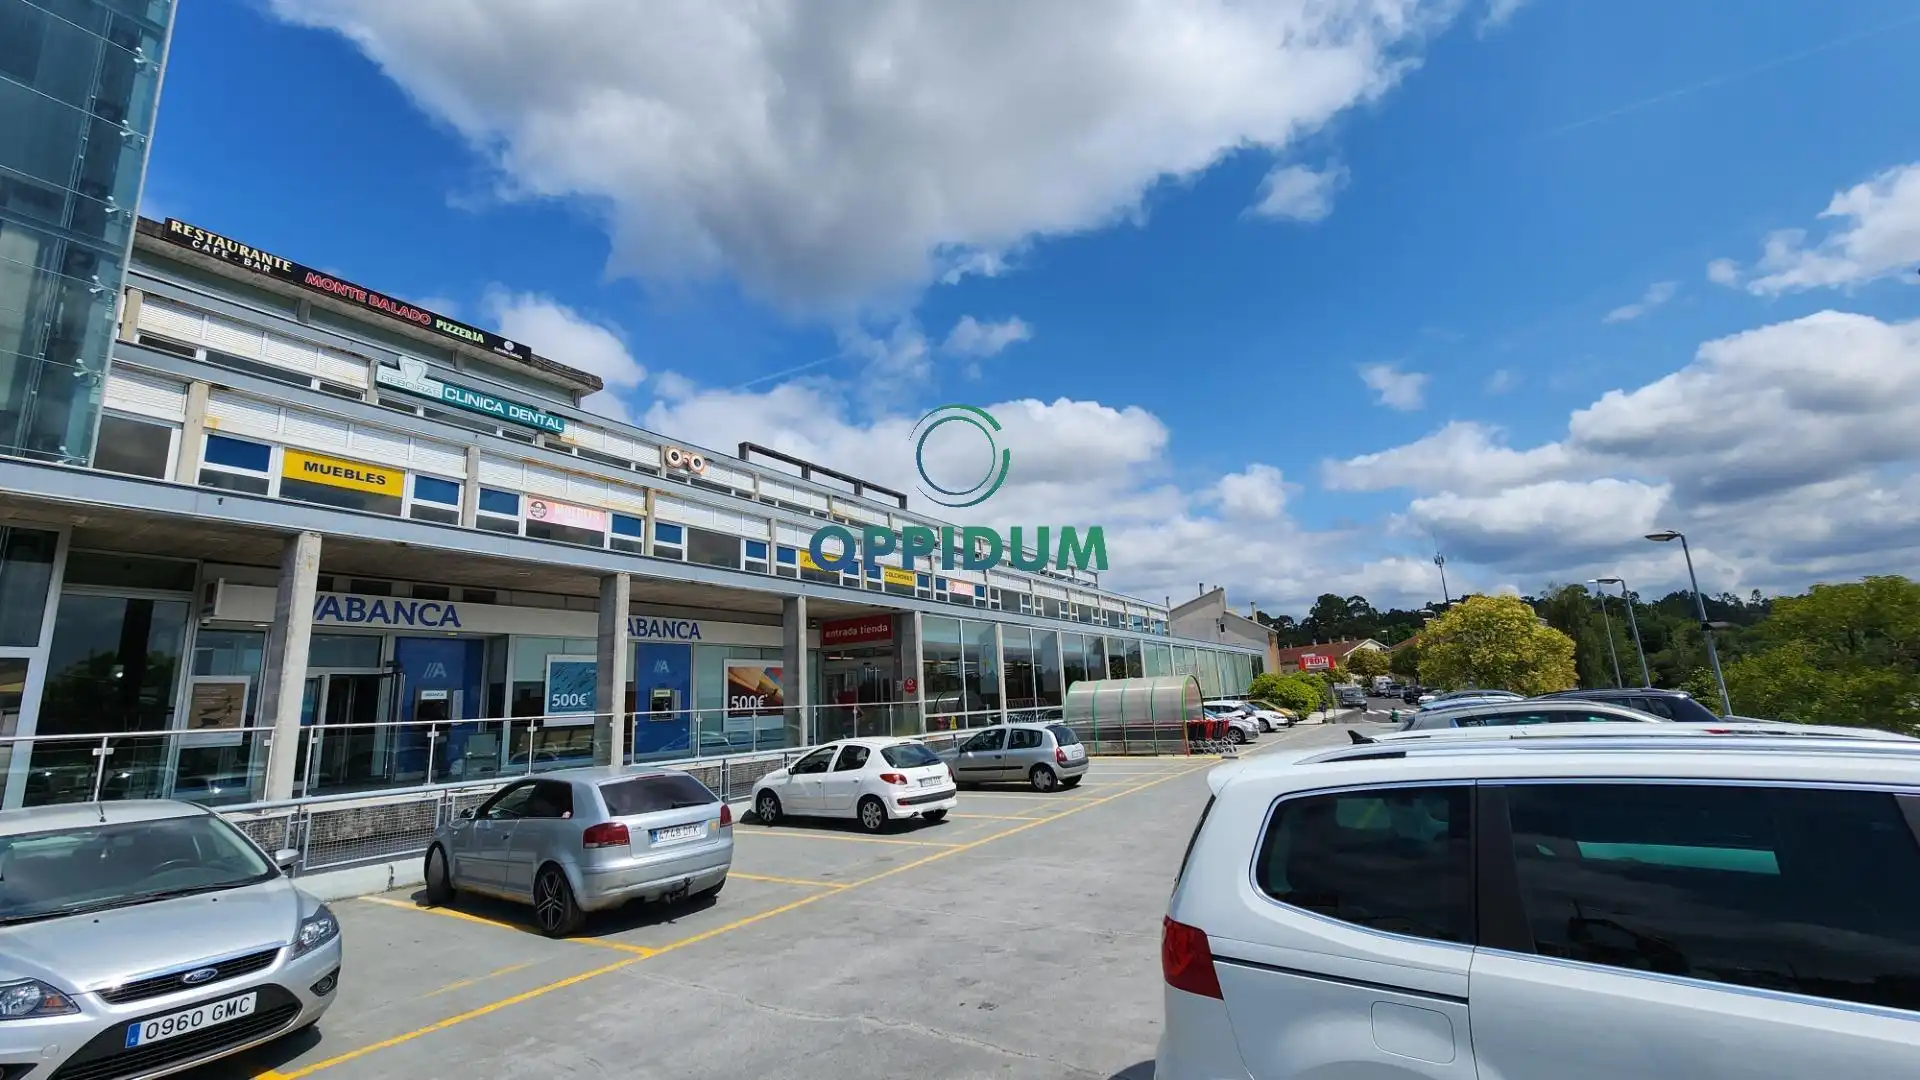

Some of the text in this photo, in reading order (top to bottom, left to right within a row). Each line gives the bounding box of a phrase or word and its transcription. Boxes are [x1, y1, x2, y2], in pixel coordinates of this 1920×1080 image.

[171, 220, 293, 272] RESTAURANTE
[192, 240, 229, 259] CAFE
[243, 258, 271, 273] BAR
[305, 272, 432, 325] MONTE BALADO
[436, 319, 484, 343] PIZZERIA
[444, 387, 563, 431] CLINICA DENTAL
[304, 461, 386, 485] MUEBLES
[825, 623, 888, 638] entrada tienda
[146, 997, 250, 1039] 0960 GMC
